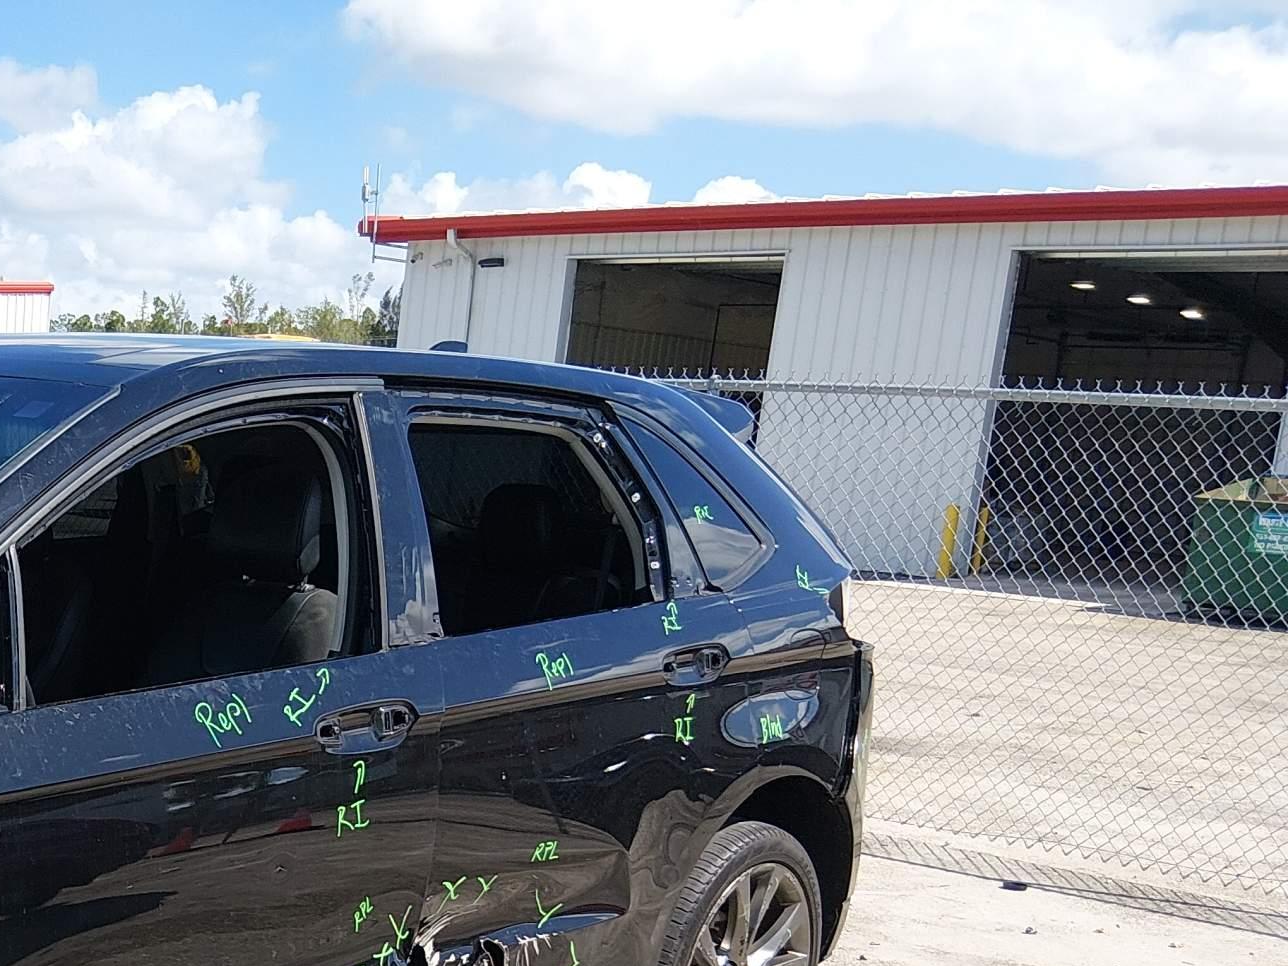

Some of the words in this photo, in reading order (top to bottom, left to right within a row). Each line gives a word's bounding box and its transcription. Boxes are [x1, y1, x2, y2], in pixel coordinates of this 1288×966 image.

[283, 687, 316, 727] RI
[674, 717, 696, 742] RI
[337, 799, 370, 837] RI
[530, 840, 560, 862] RPL
